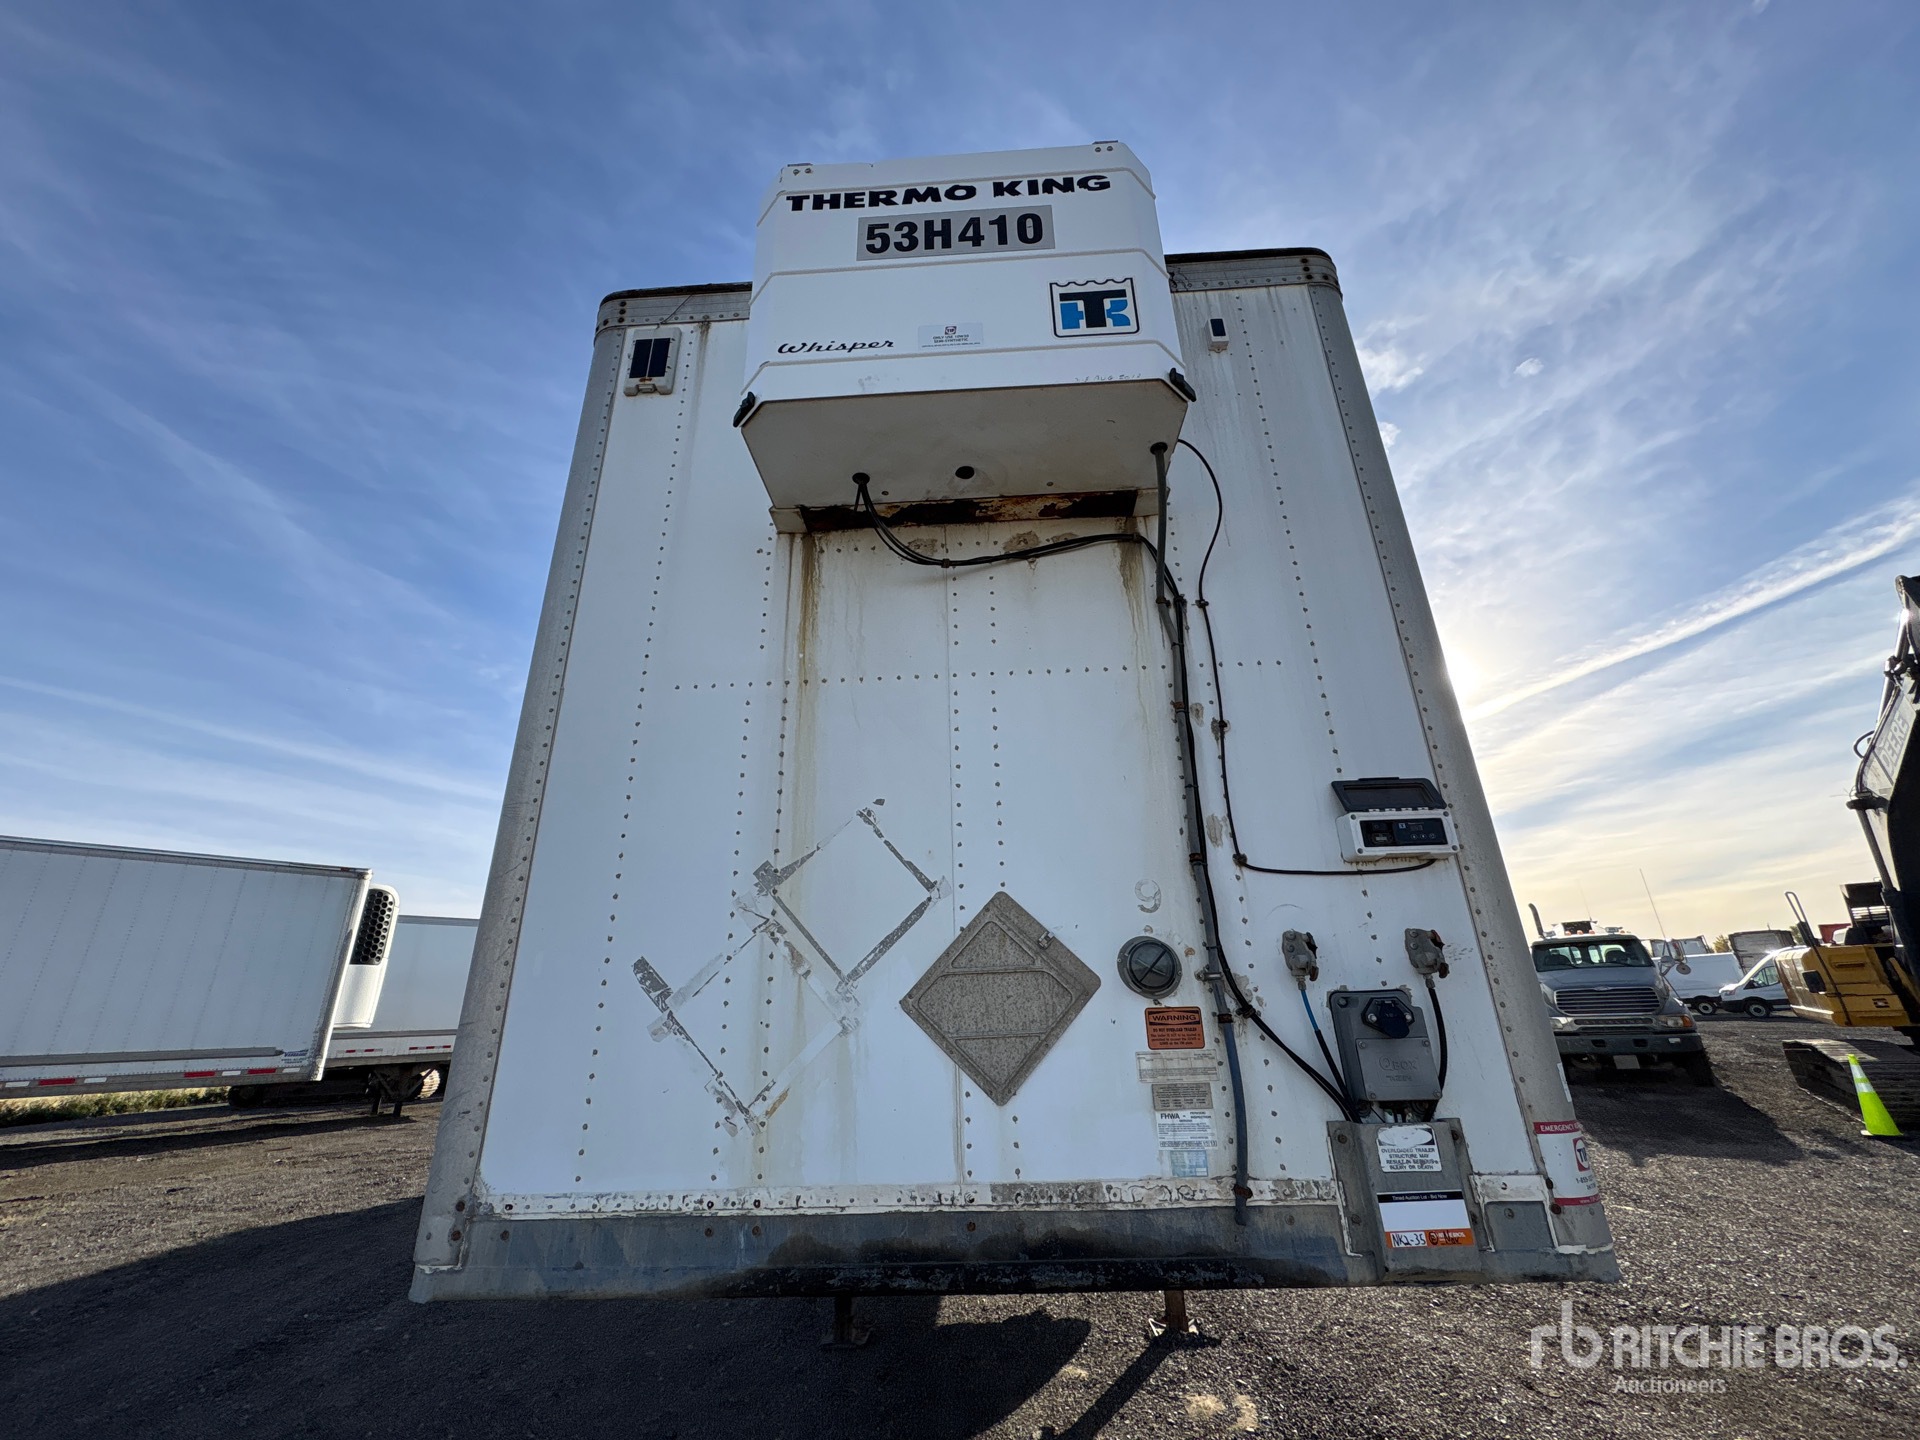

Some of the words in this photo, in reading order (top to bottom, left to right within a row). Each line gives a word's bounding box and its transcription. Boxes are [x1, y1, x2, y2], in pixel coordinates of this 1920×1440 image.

[786, 184, 977, 212] THERMO
[992, 174, 1111, 198] KING
[865, 212, 1044, 254] 53H410
[777, 338, 895, 354] Whisper
[1152, 1014, 1197, 1022] WARNING
[1160, 1112, 1180, 1120] FHWA
